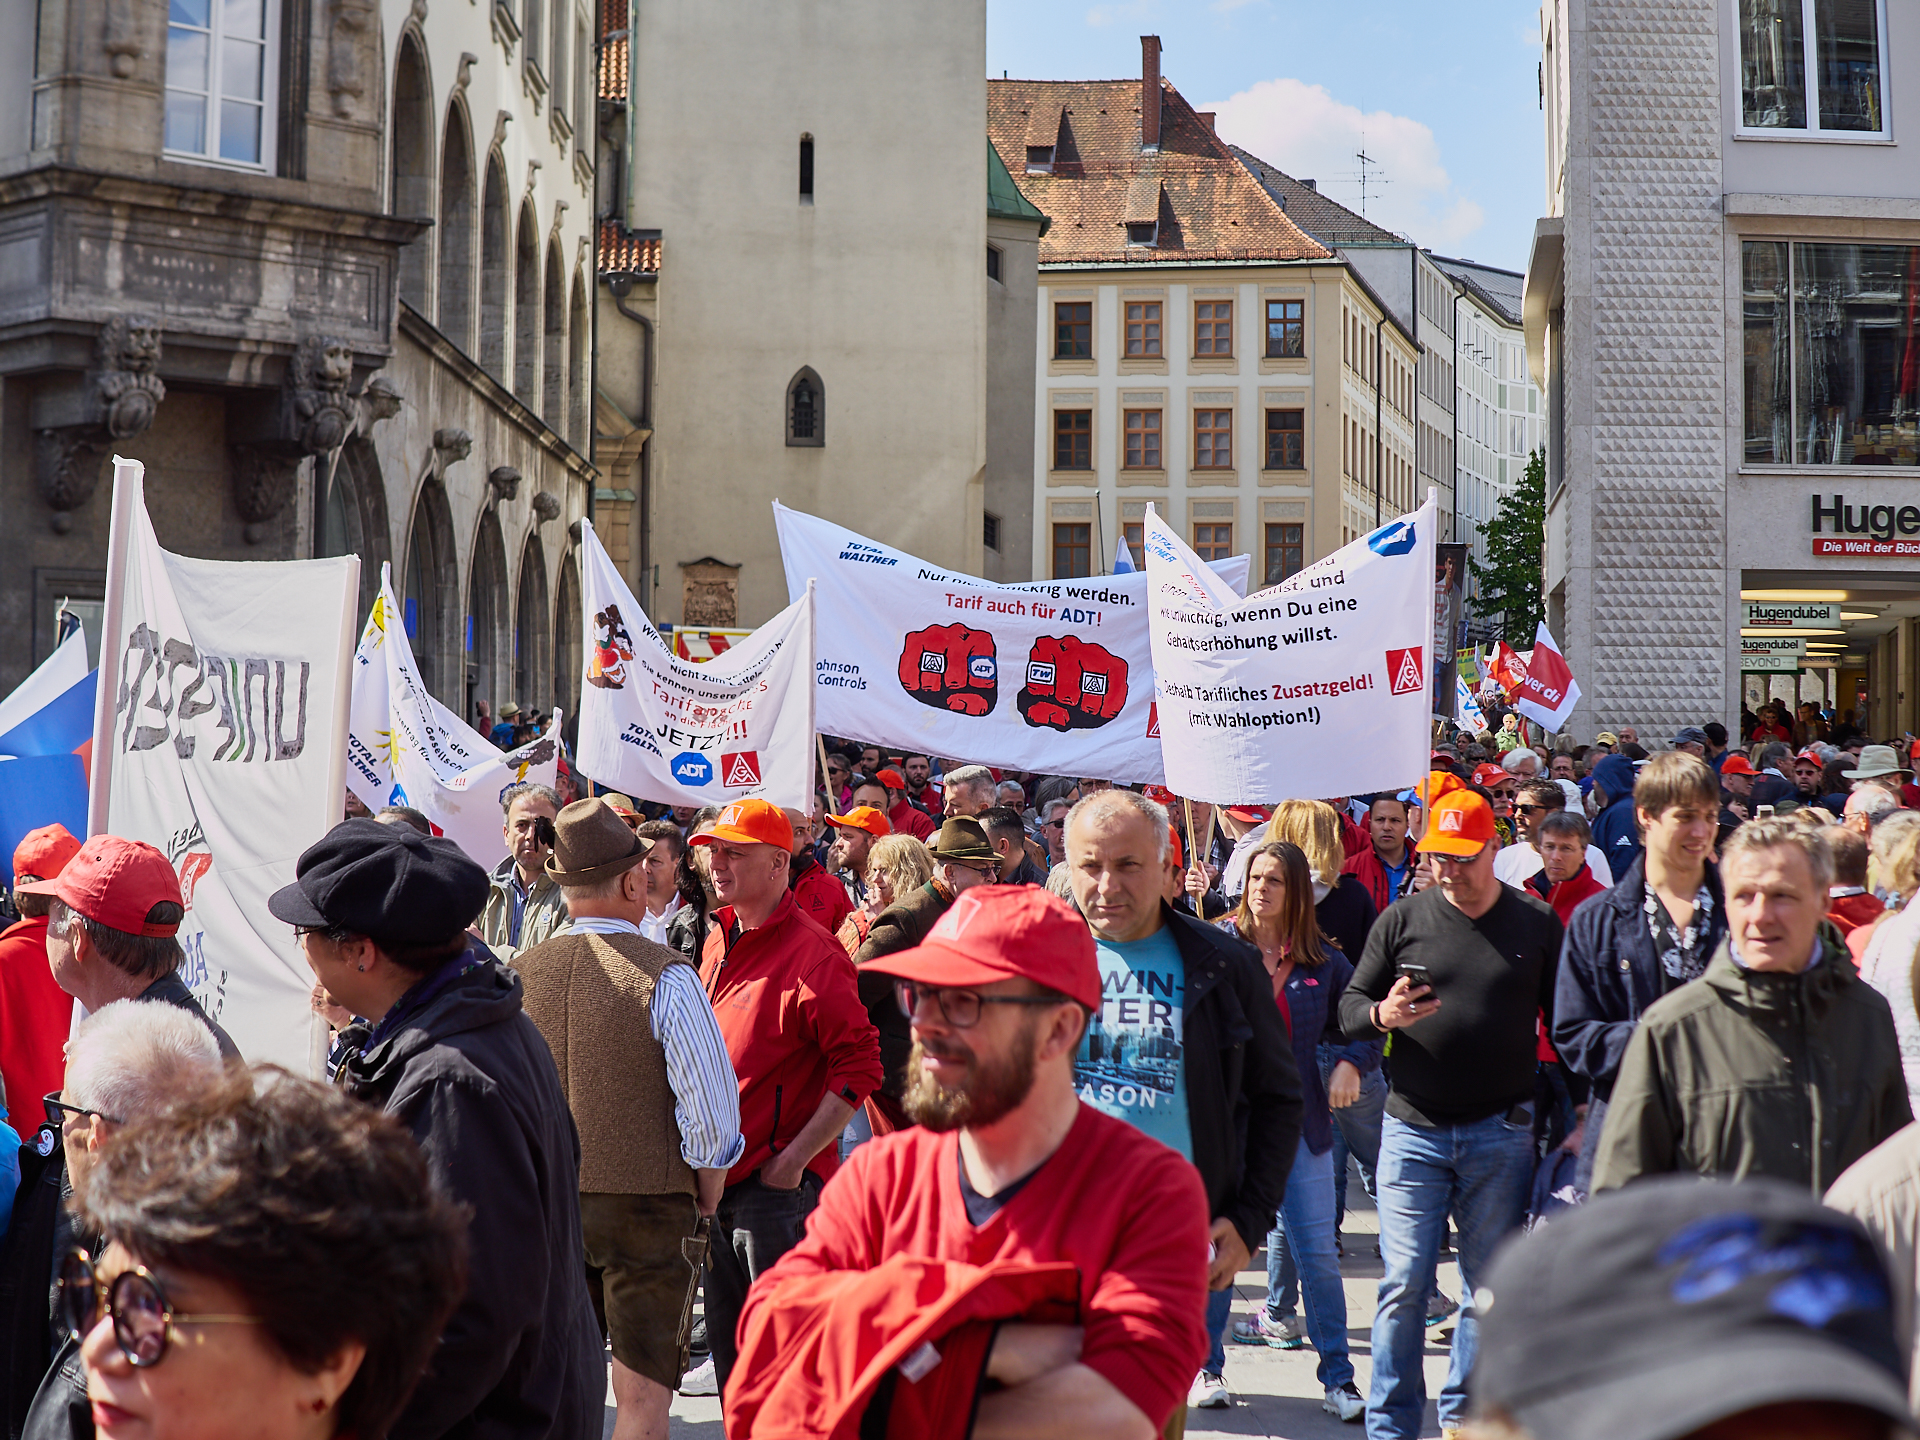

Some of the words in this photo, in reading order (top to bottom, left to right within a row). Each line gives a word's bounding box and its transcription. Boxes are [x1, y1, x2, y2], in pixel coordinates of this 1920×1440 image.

[1812, 494, 1920, 542] Huge
[1822, 541, 1842, 552] Die
[1845, 541, 1871, 552] Welt
[1873, 542, 1894, 553] der
[1895, 542, 1920, 553] Büc
[838, 551, 898, 566] WALTHER
[917, 568, 949, 582] Nur
[1066, 586, 1136, 606] werden.
[1311, 570, 1345, 589] und
[945, 593, 983, 609] Tarif
[986, 600, 1026, 616] auch
[1031, 602, 1056, 619] für
[1060, 607, 1102, 627] ADT!
[1231, 607, 1281, 623] wenn
[1287, 601, 1313, 617] Du
[1318, 597, 1357, 614] eine
[1749, 605, 1830, 620] Hugendubel
[642, 623, 659, 642] Wir
[1166, 631, 1278, 651] Gehaltserhöhung
[1282, 626, 1338, 645] willst.
[670, 664, 699, 680] Nicht
[702, 673, 726, 685] zum
[816, 659, 859, 674] ohnson
[974, 665, 992, 674] ADT
[1032, 669, 1051, 678] TW
[656, 671, 695, 695] kennen
[698, 690, 737, 700] unsere
[817, 674, 867, 690] Controls
[1195, 686, 1268, 702] Tarifliches
[1271, 673, 1374, 700] Zusatzgeld!
[1524, 674, 1562, 703] ver.di
[664, 710, 677, 721] an
[680, 716, 697, 728] die
[1213, 706, 1321, 730] Wahloption!)
[450, 742, 470, 758] der
[676, 763, 707, 778] ADT
[1096, 998, 1172, 1026] TER
[1070, 1082, 1157, 1109] ASON
